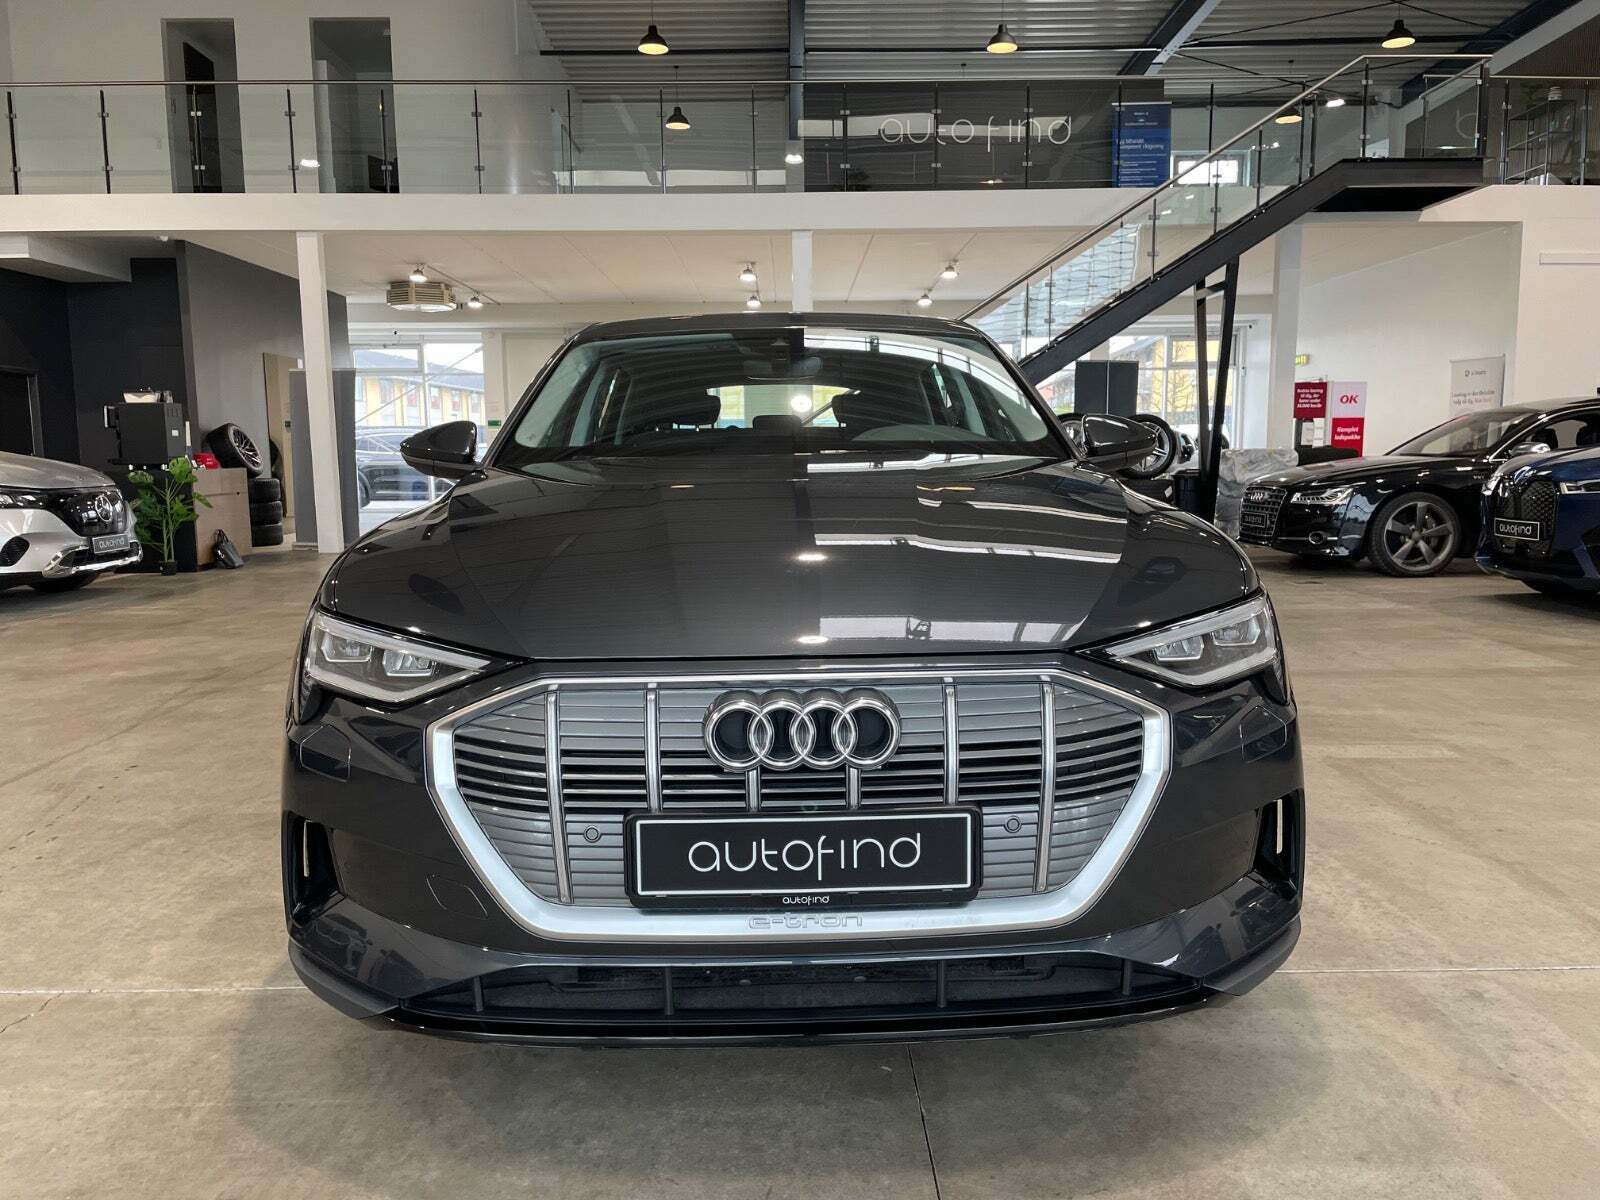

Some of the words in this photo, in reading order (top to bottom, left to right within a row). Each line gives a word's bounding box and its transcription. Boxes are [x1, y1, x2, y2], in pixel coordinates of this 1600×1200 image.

[880, 116, 1072, 152] autofind
[1339, 394, 1359, 404] OK
[1499, 523, 1532, 536] autofind
[688, 832, 921, 881] autofind
[782, 895, 830, 906] autofind
[749, 912, 863, 929] e-tron
